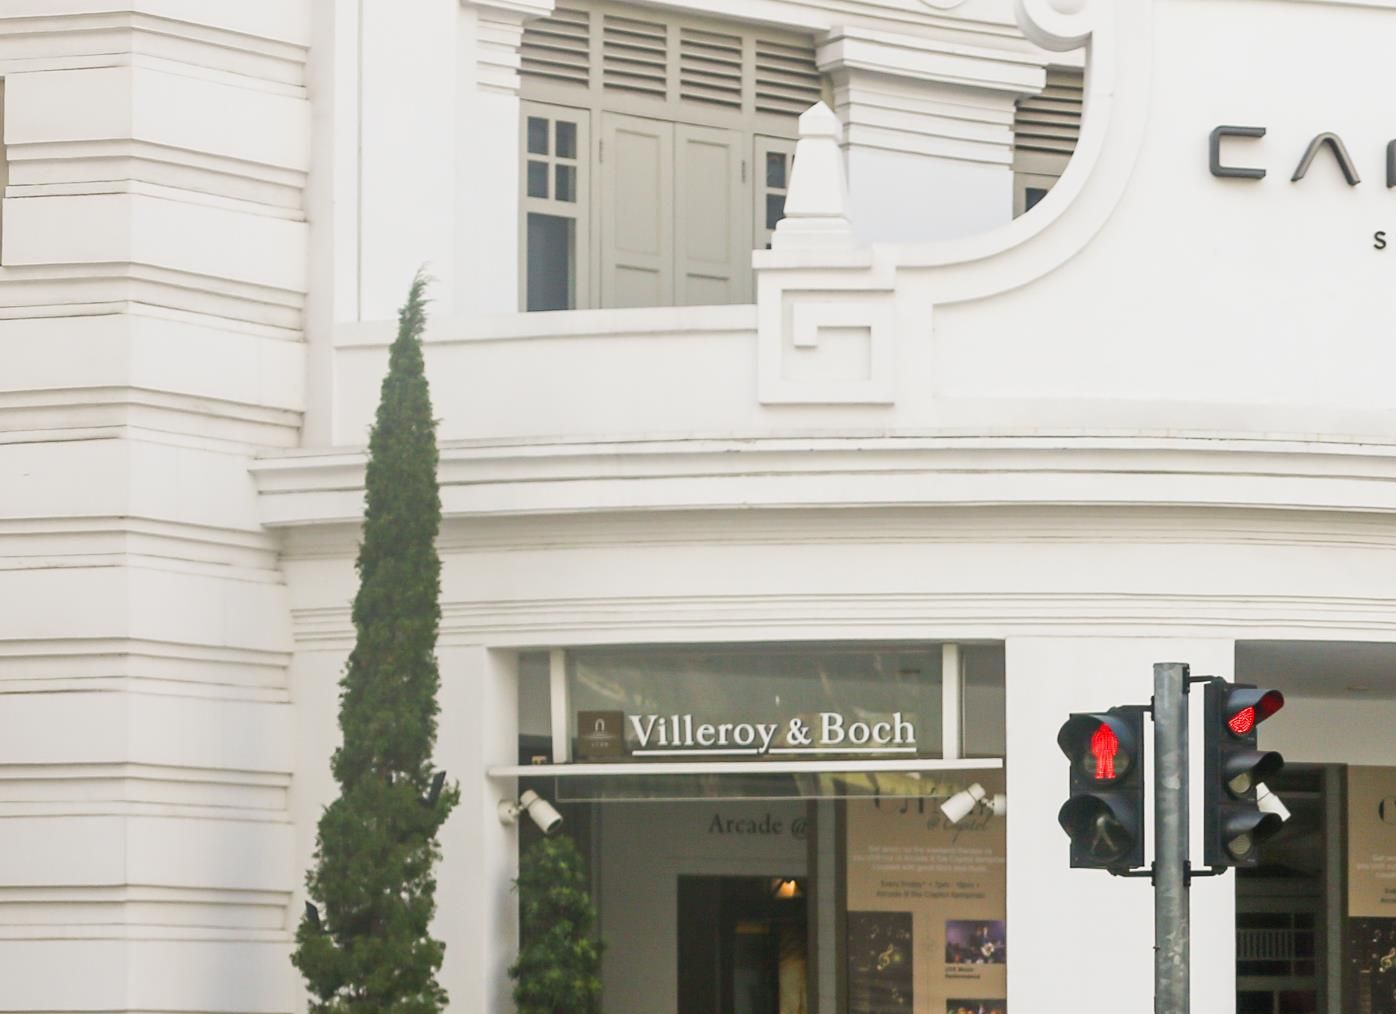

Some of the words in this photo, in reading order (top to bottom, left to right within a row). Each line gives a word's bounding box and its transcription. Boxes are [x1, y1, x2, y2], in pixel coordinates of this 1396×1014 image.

[629, 715, 778, 754] Villeroy
[786, 718, 812, 745] &
[819, 712, 916, 745] Boch
[708, 814, 783, 836] Arcade
